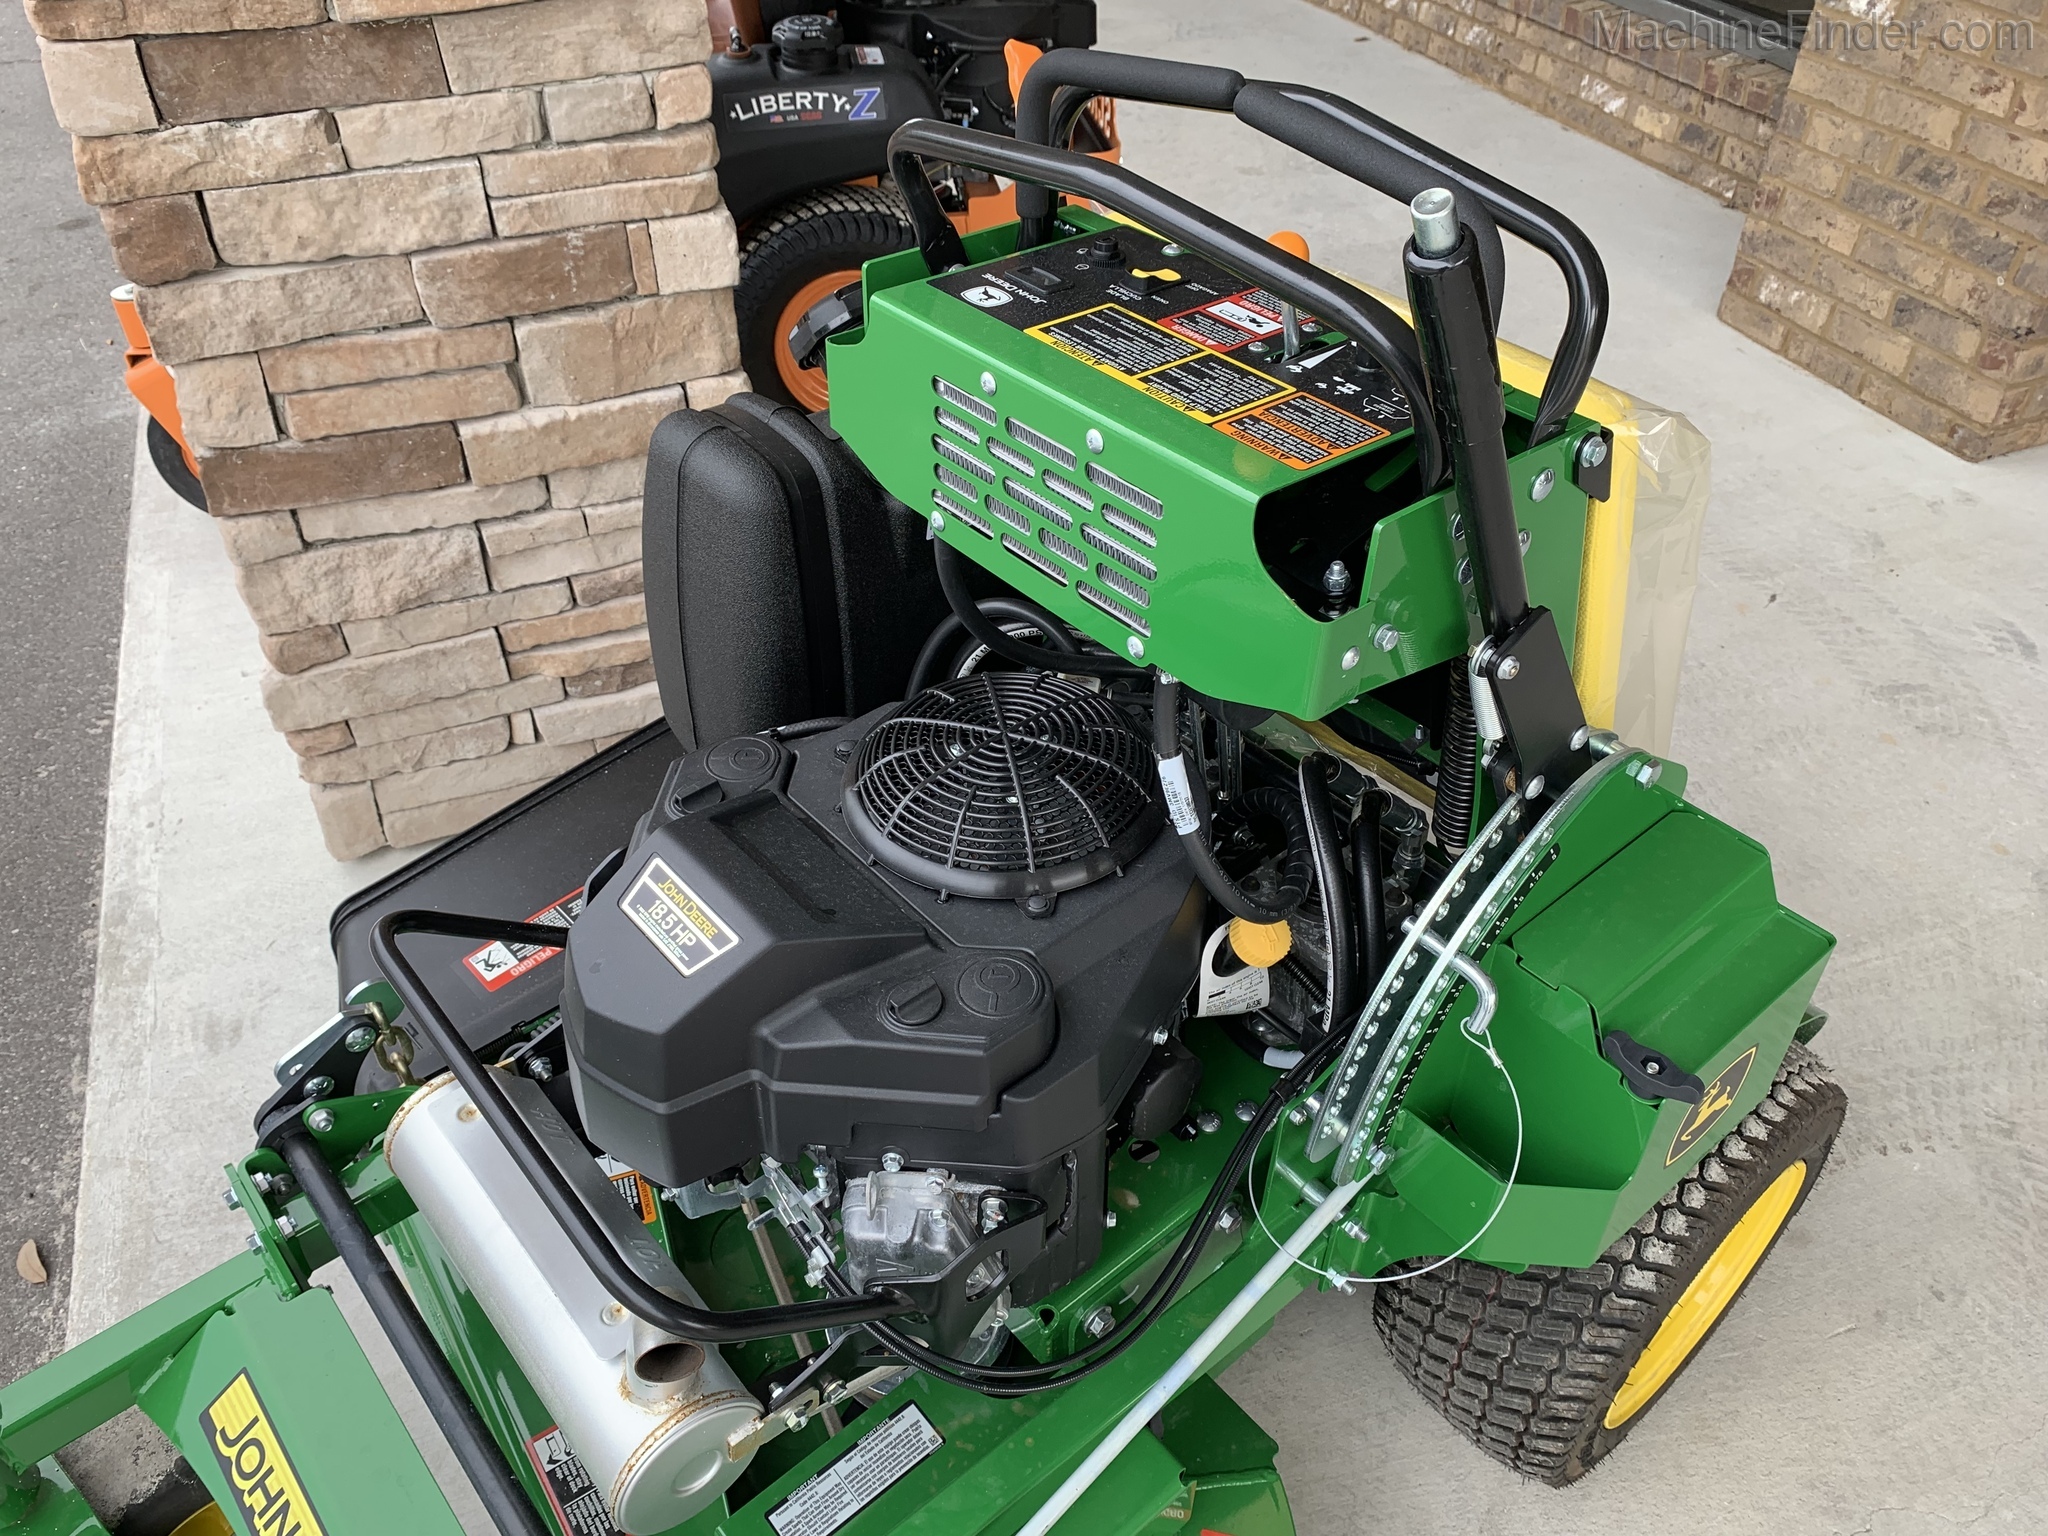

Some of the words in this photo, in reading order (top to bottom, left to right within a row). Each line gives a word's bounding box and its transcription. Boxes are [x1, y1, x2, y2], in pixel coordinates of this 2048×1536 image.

[734, 90, 848, 120] LIBERTY
[848, 87, 880, 120] Z
[982, 273, 1018, 291] DEERE
[1015, 289, 1047, 303] JOHN
[1237, 299, 1279, 318] PELIGRO
[1168, 324, 1209, 341] DANGER
[1140, 386, 1186, 408] CAUTION
[1256, 410, 1328, 445] ADVERTENCIA
[1228, 430, 1282, 455] WARNING
[658, 879, 688, 908] JOHN
[683, 901, 718, 939] DEERE
[648, 900, 678, 930] 18.5
[670, 924, 696, 946] HP
[510, 949, 552, 976] PELIGRO
[856, 1417, 891, 1445] IMPORTANTE
[219, 1414, 301, 1536] JOHN
[786, 1473, 819, 1500] IMPORTANT
[791, 1491, 807, 1504] California
